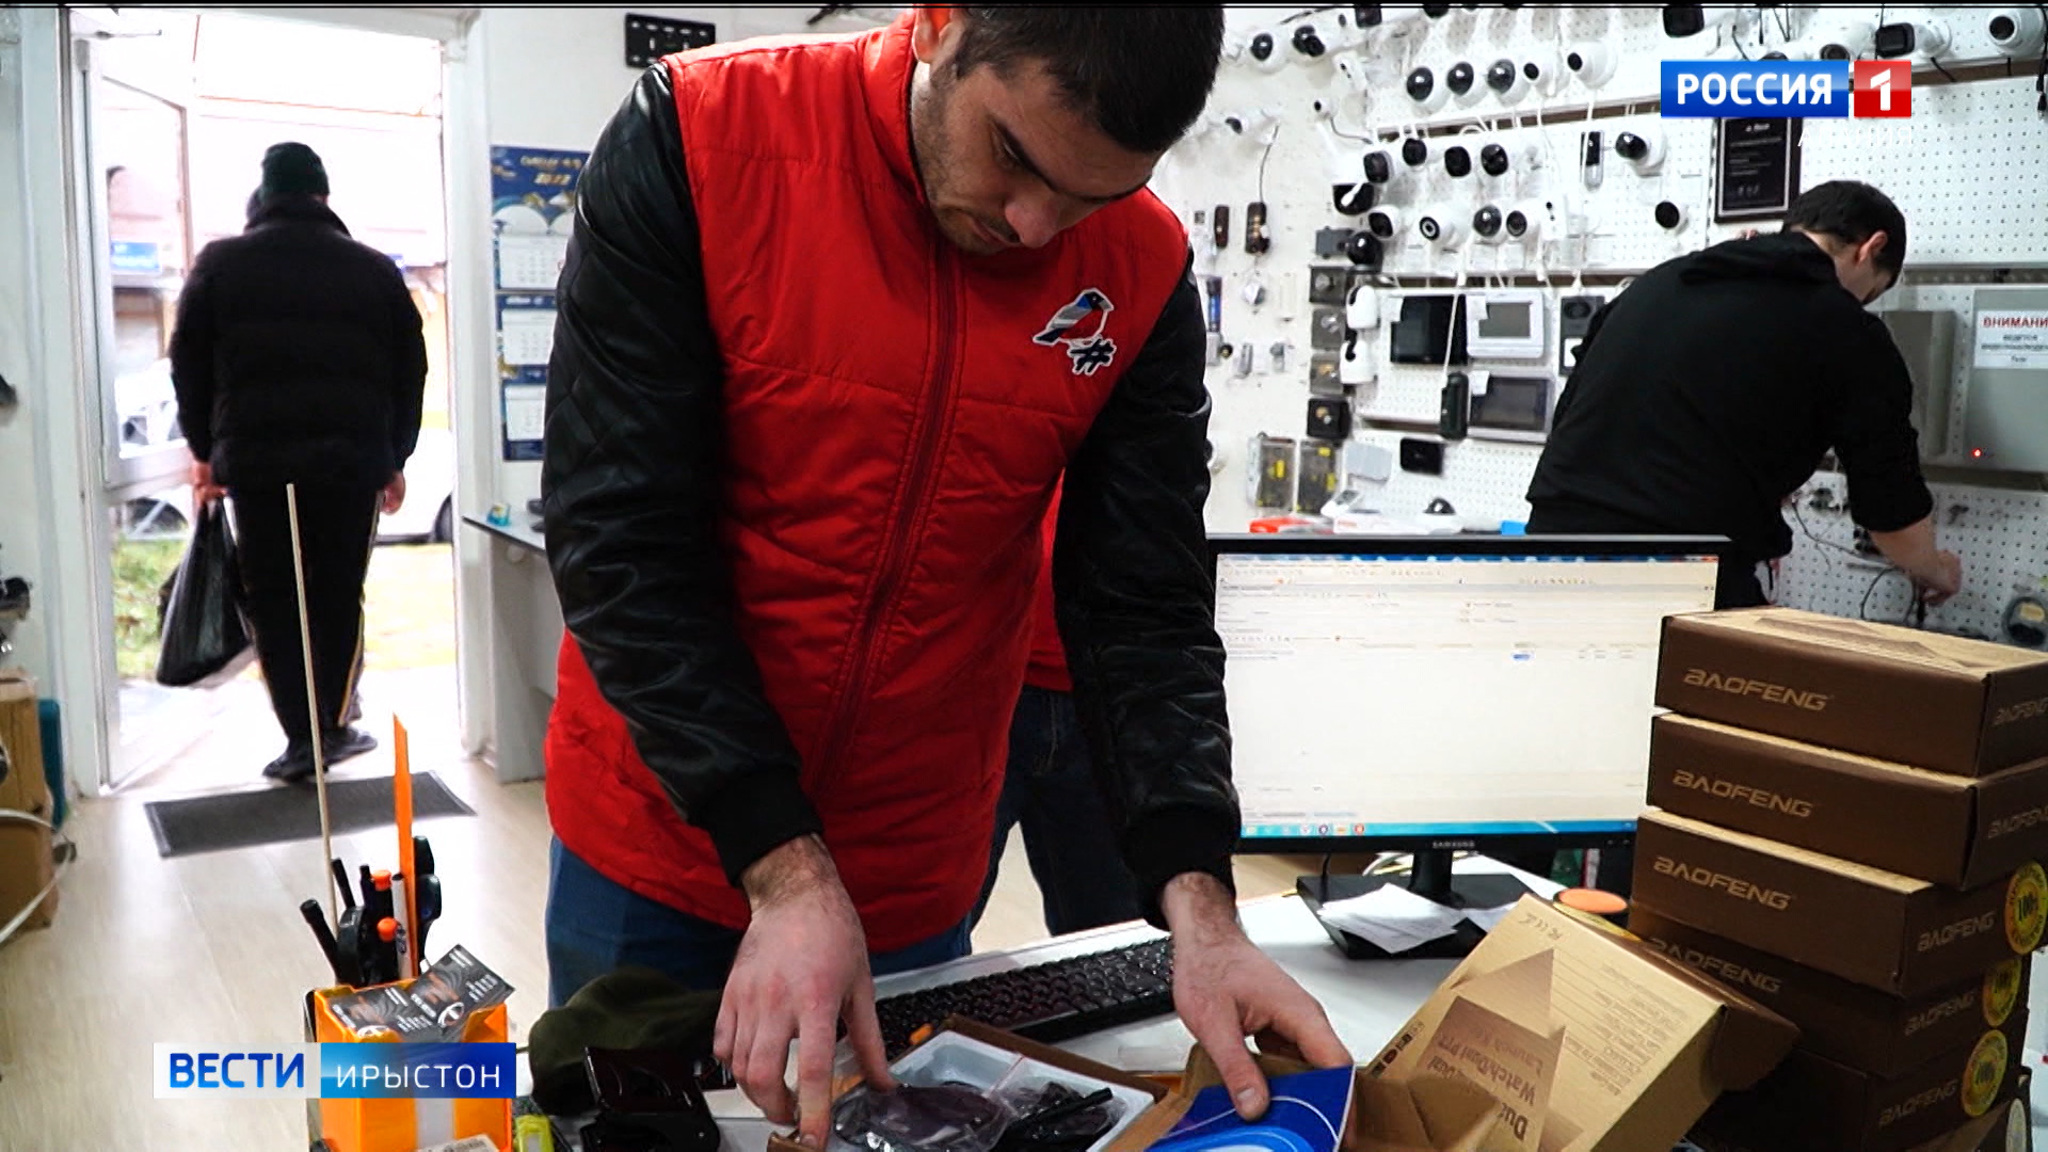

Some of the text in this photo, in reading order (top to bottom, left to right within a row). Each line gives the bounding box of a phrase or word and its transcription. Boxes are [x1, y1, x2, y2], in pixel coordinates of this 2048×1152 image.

[1683, 668, 1829, 711] BAOFENG
[1672, 769, 1814, 818] BAOFENG
[1653, 856, 1793, 911] BAOFENG
[1917, 911, 1996, 952] BAOFENG
